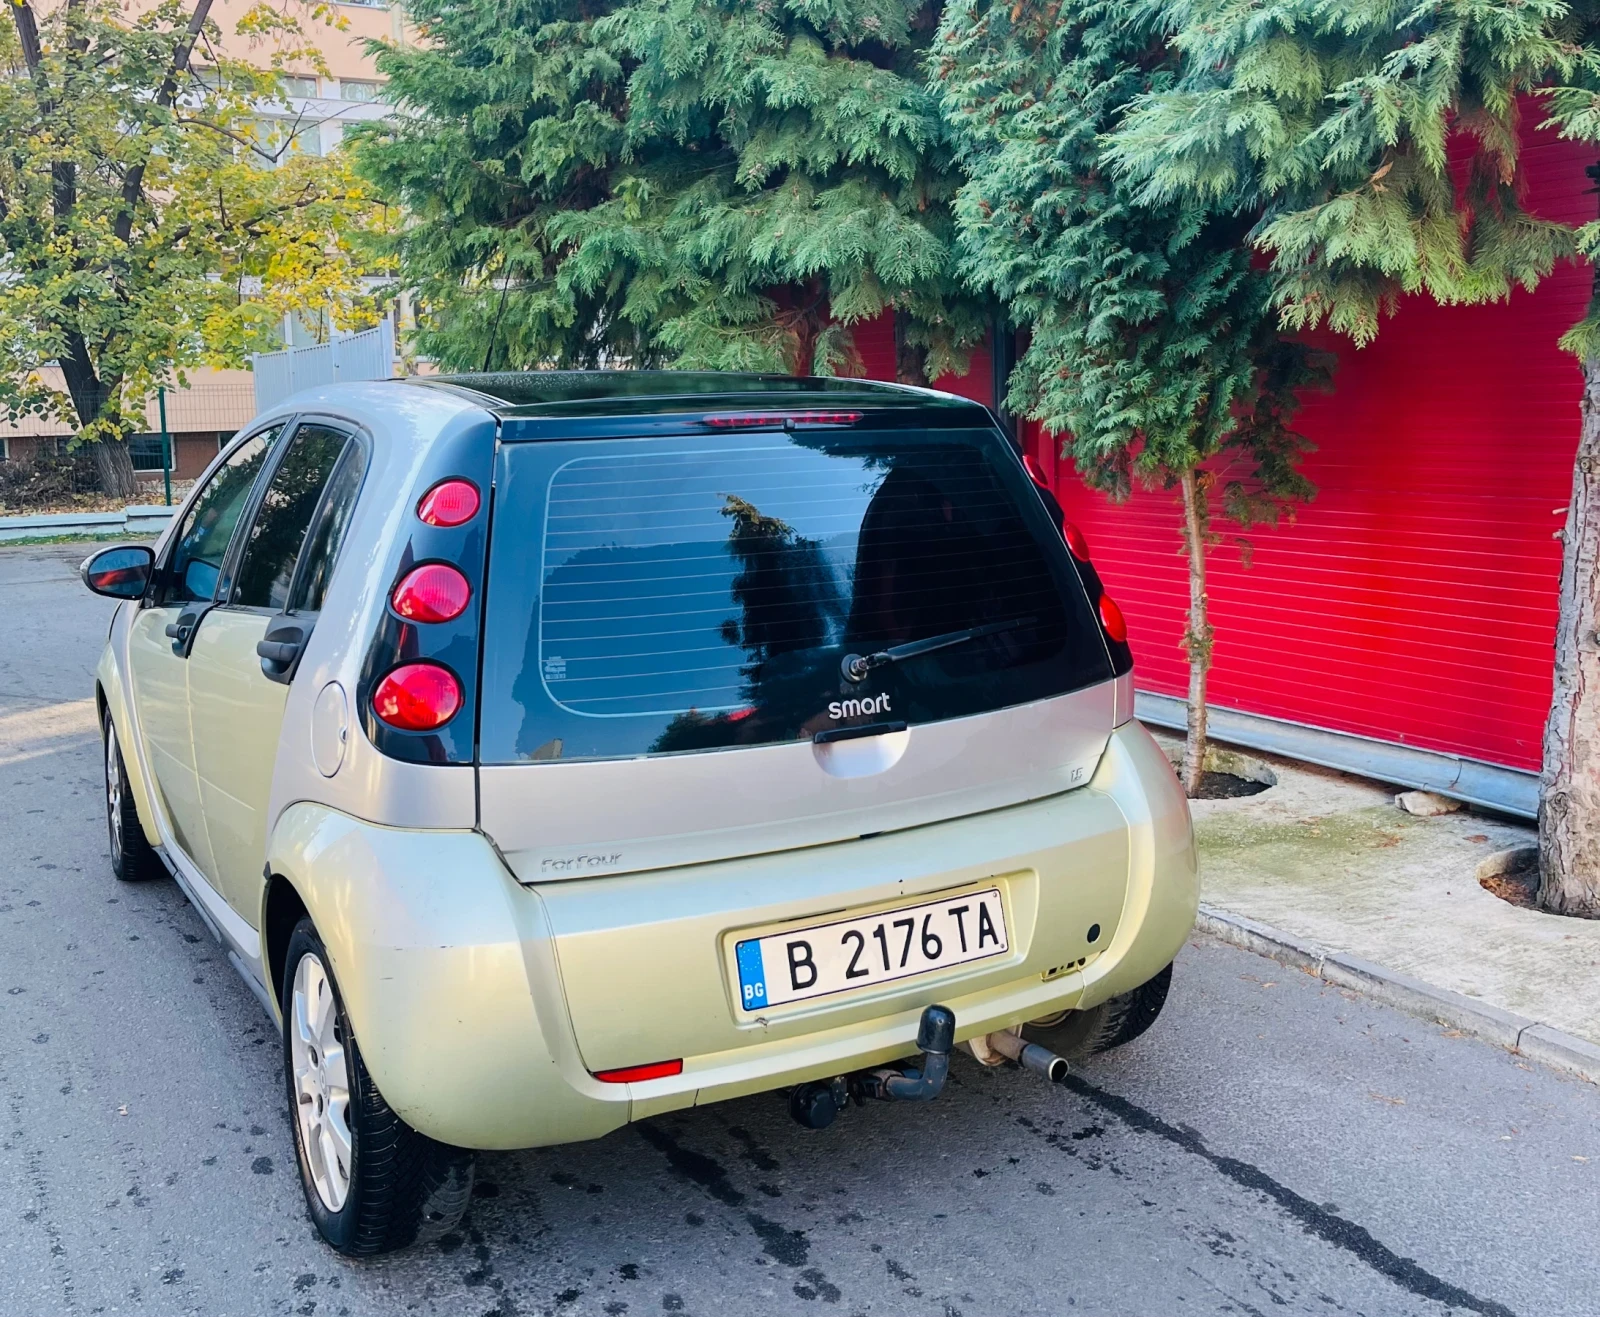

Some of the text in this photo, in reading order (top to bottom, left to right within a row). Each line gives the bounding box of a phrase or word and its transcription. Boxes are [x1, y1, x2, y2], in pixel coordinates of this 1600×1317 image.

[828, 692, 892, 719] smart
[786, 901, 1000, 991] B 2176 TA
[744, 982, 764, 1000] BG
